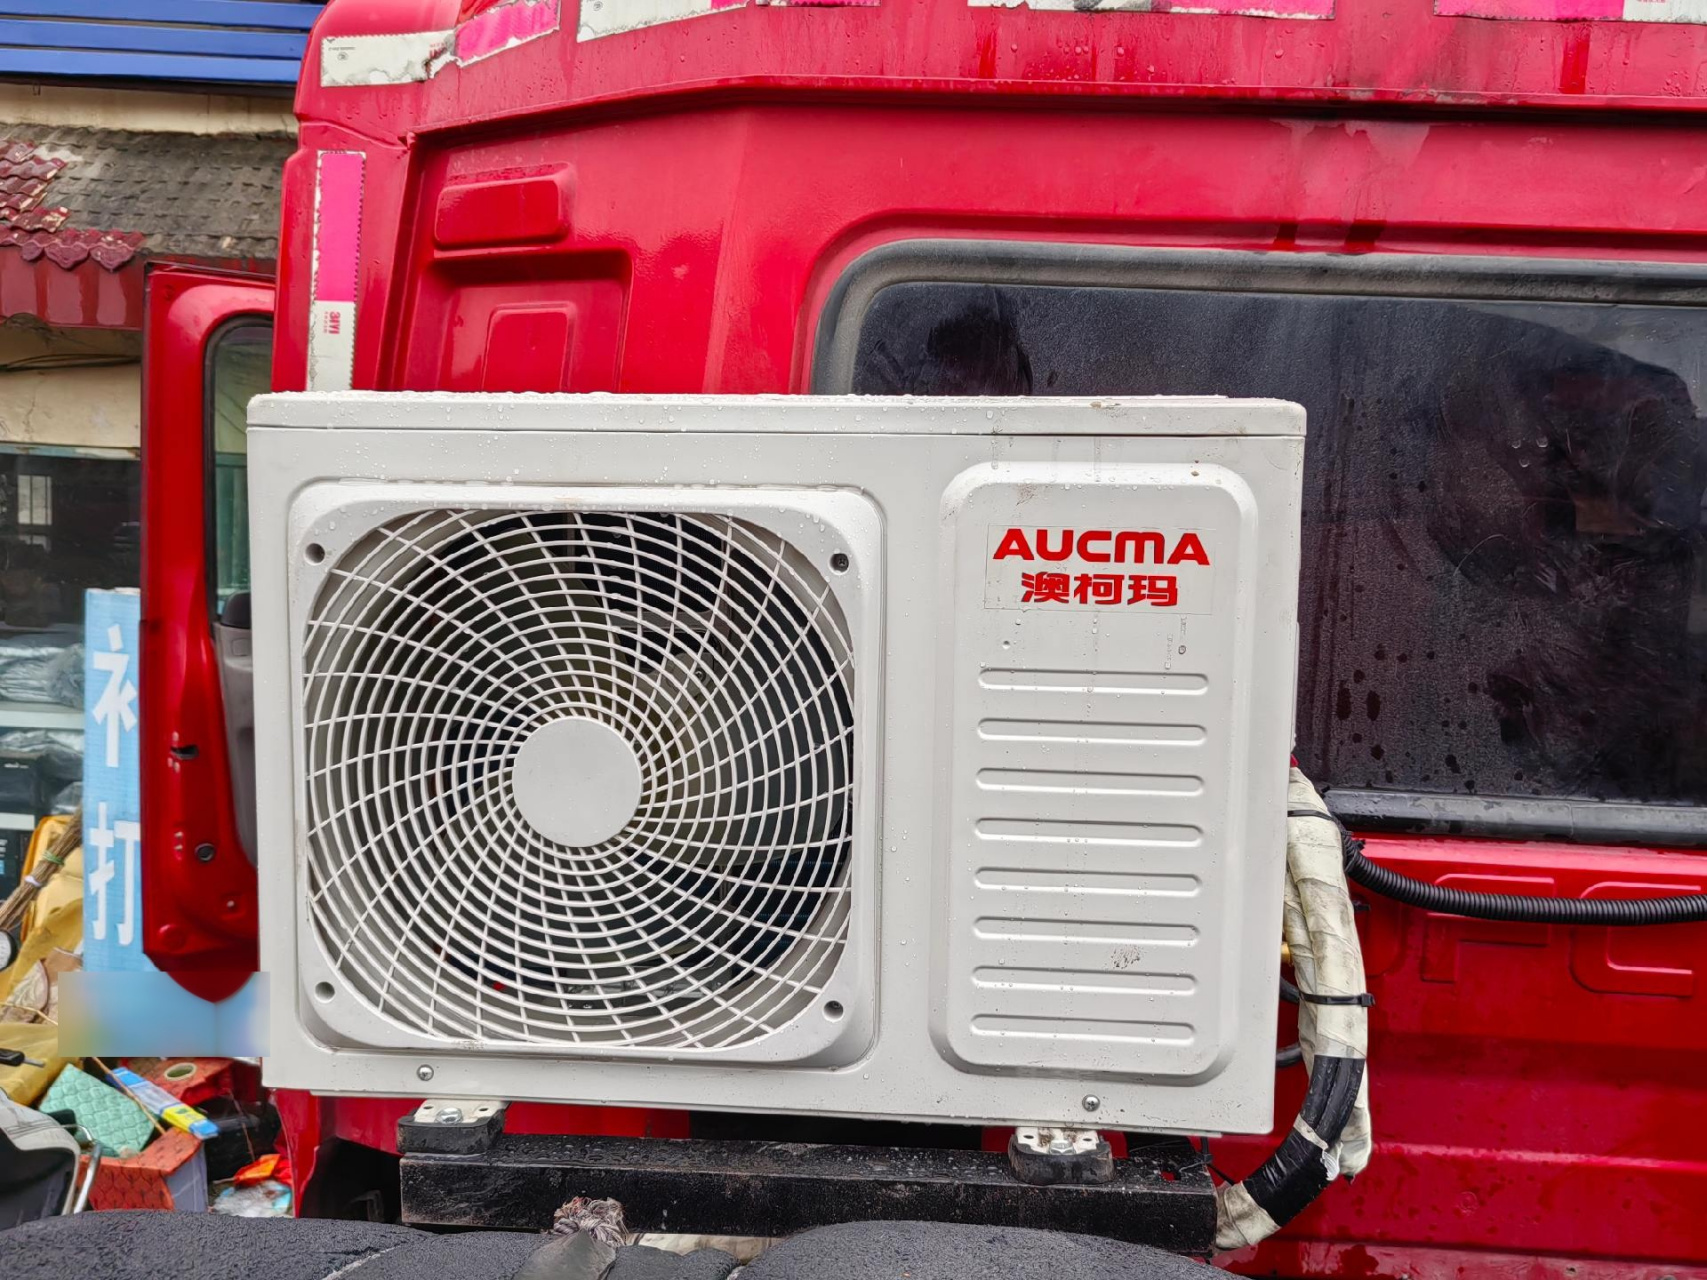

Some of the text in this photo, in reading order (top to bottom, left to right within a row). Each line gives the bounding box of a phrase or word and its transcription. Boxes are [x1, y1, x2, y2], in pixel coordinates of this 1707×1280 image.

[992, 528, 1211, 566] AUCMA
[1020, 571, 1179, 607] 澳柯玛
